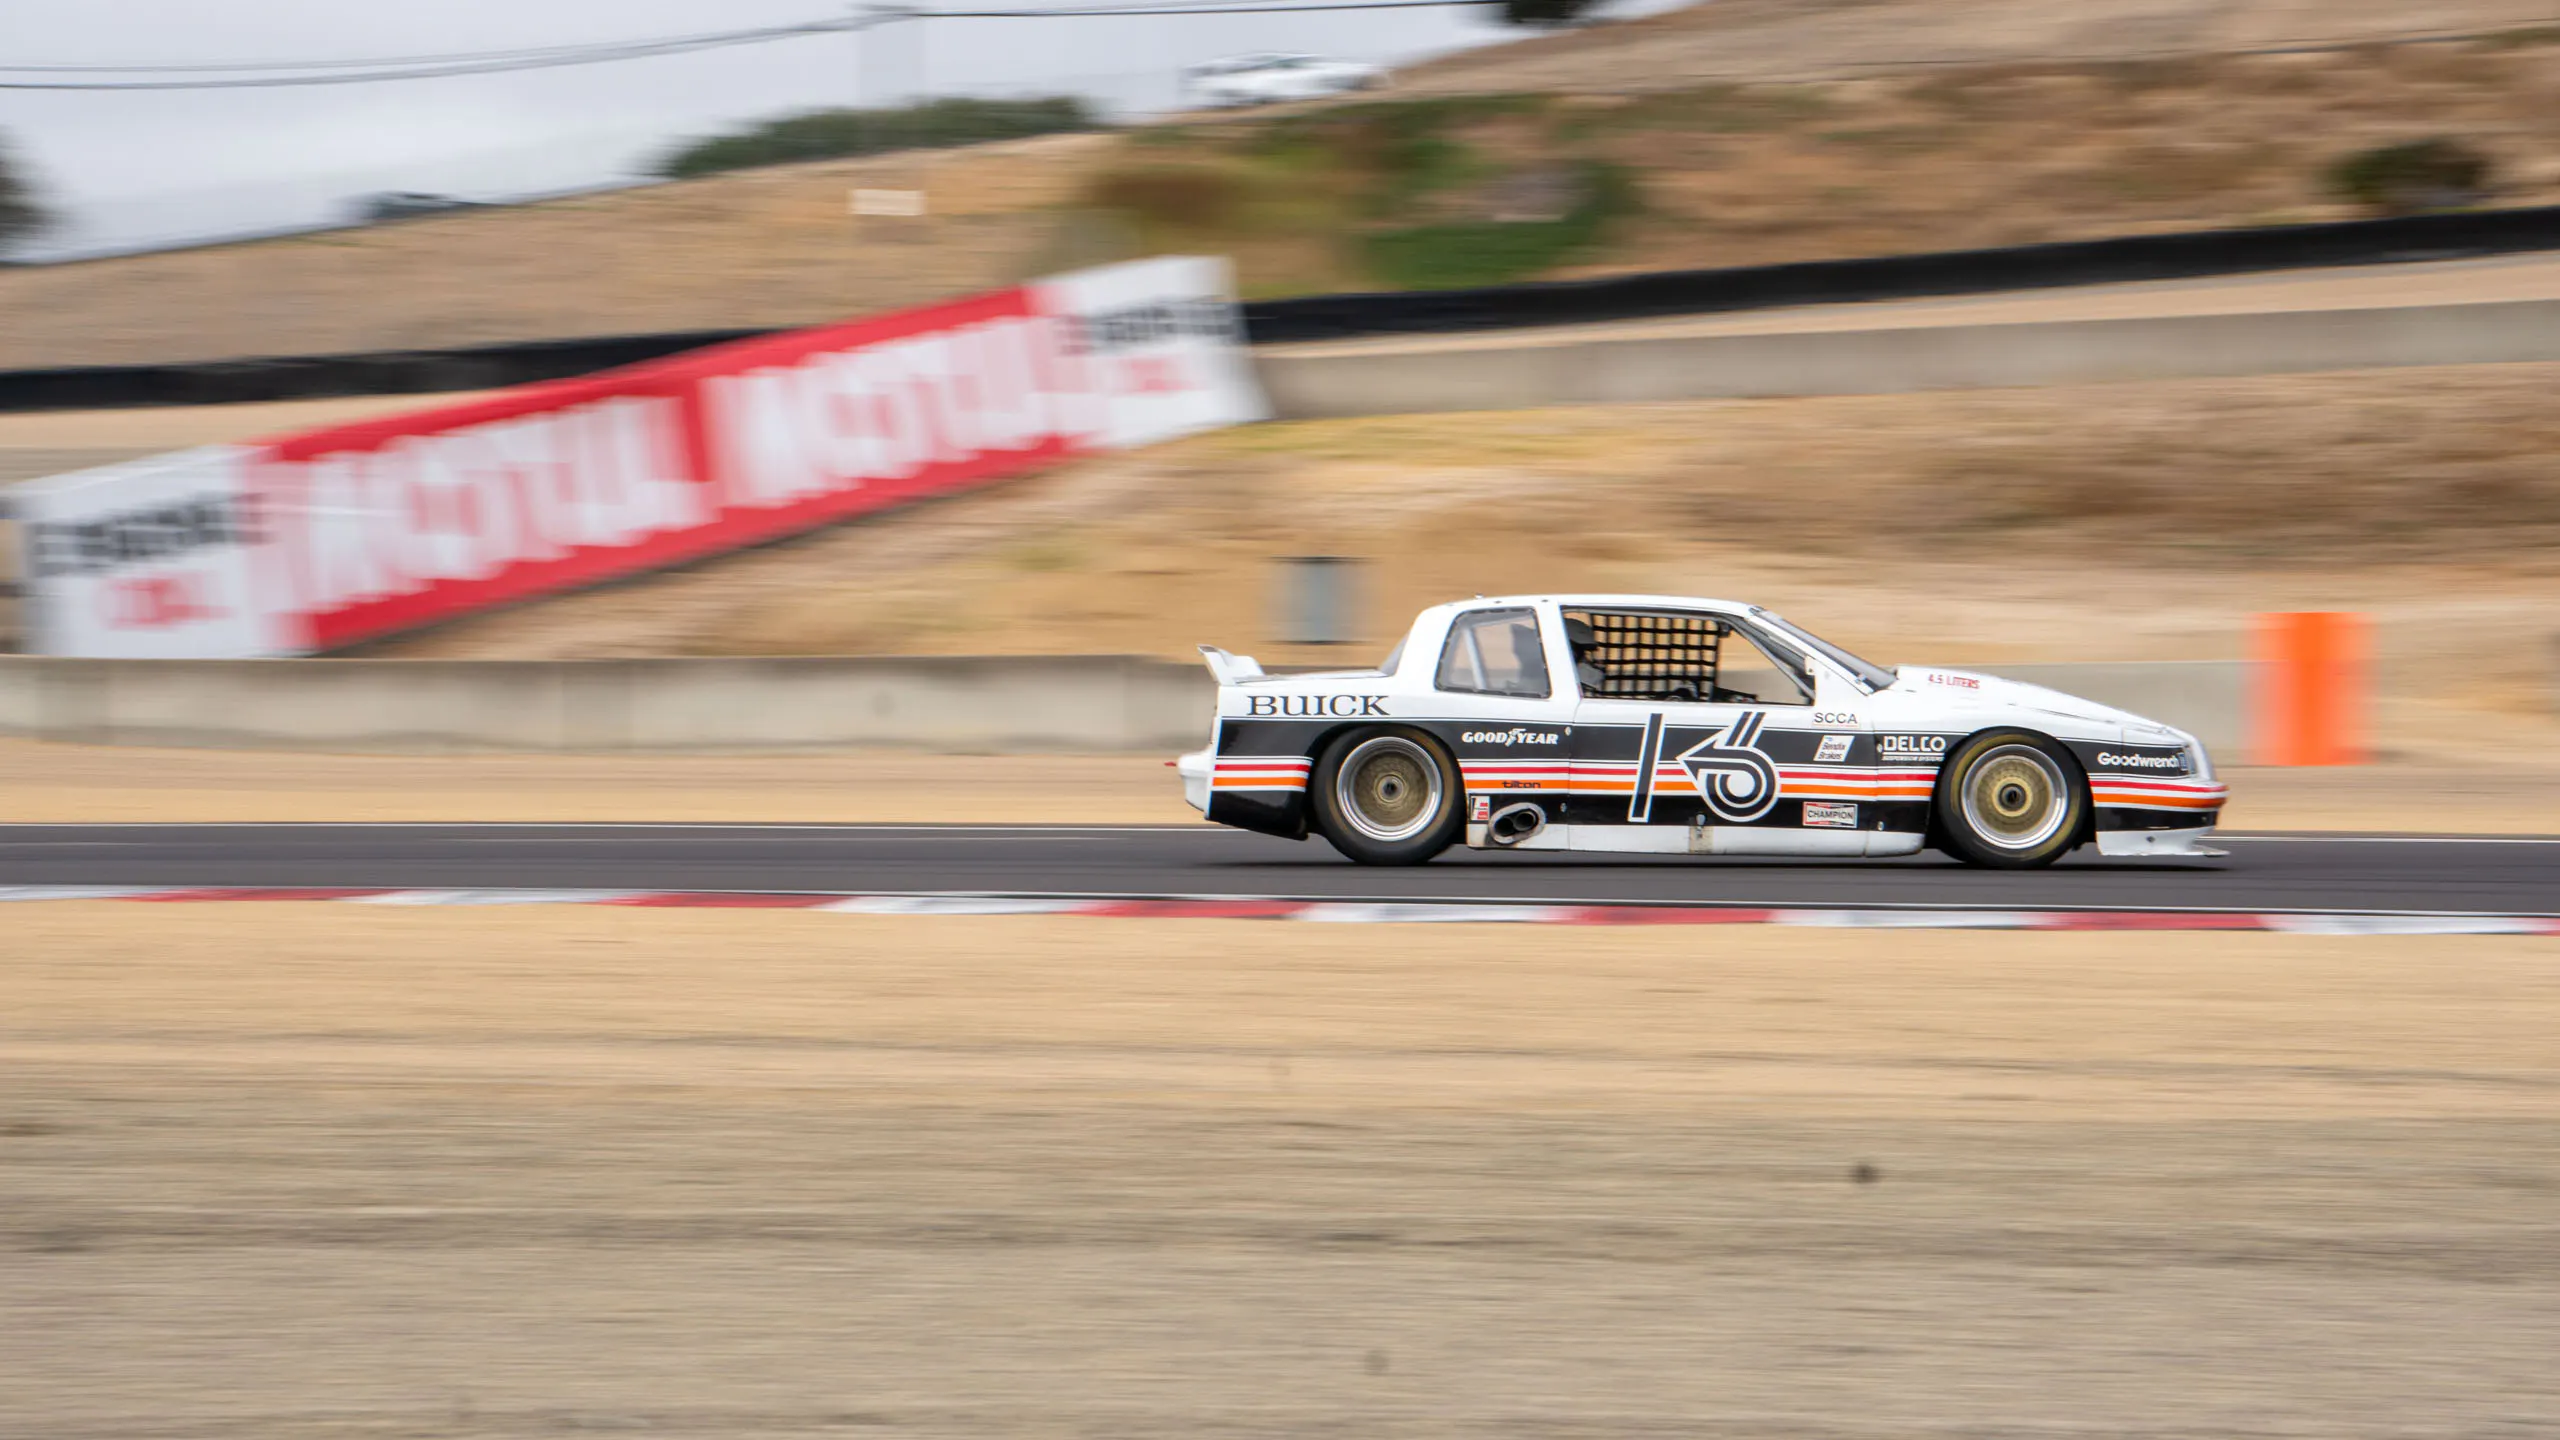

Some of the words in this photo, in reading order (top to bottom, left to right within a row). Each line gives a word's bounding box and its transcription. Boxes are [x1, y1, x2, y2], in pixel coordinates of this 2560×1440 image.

[1246, 694, 1391, 717] BUICK
[1813, 711, 1859, 724] SCCA
[1461, 727, 1559, 747] GOODYEAR
[1883, 735, 1947, 752] DELCO
[1807, 809, 1854, 820] CHAMPION
